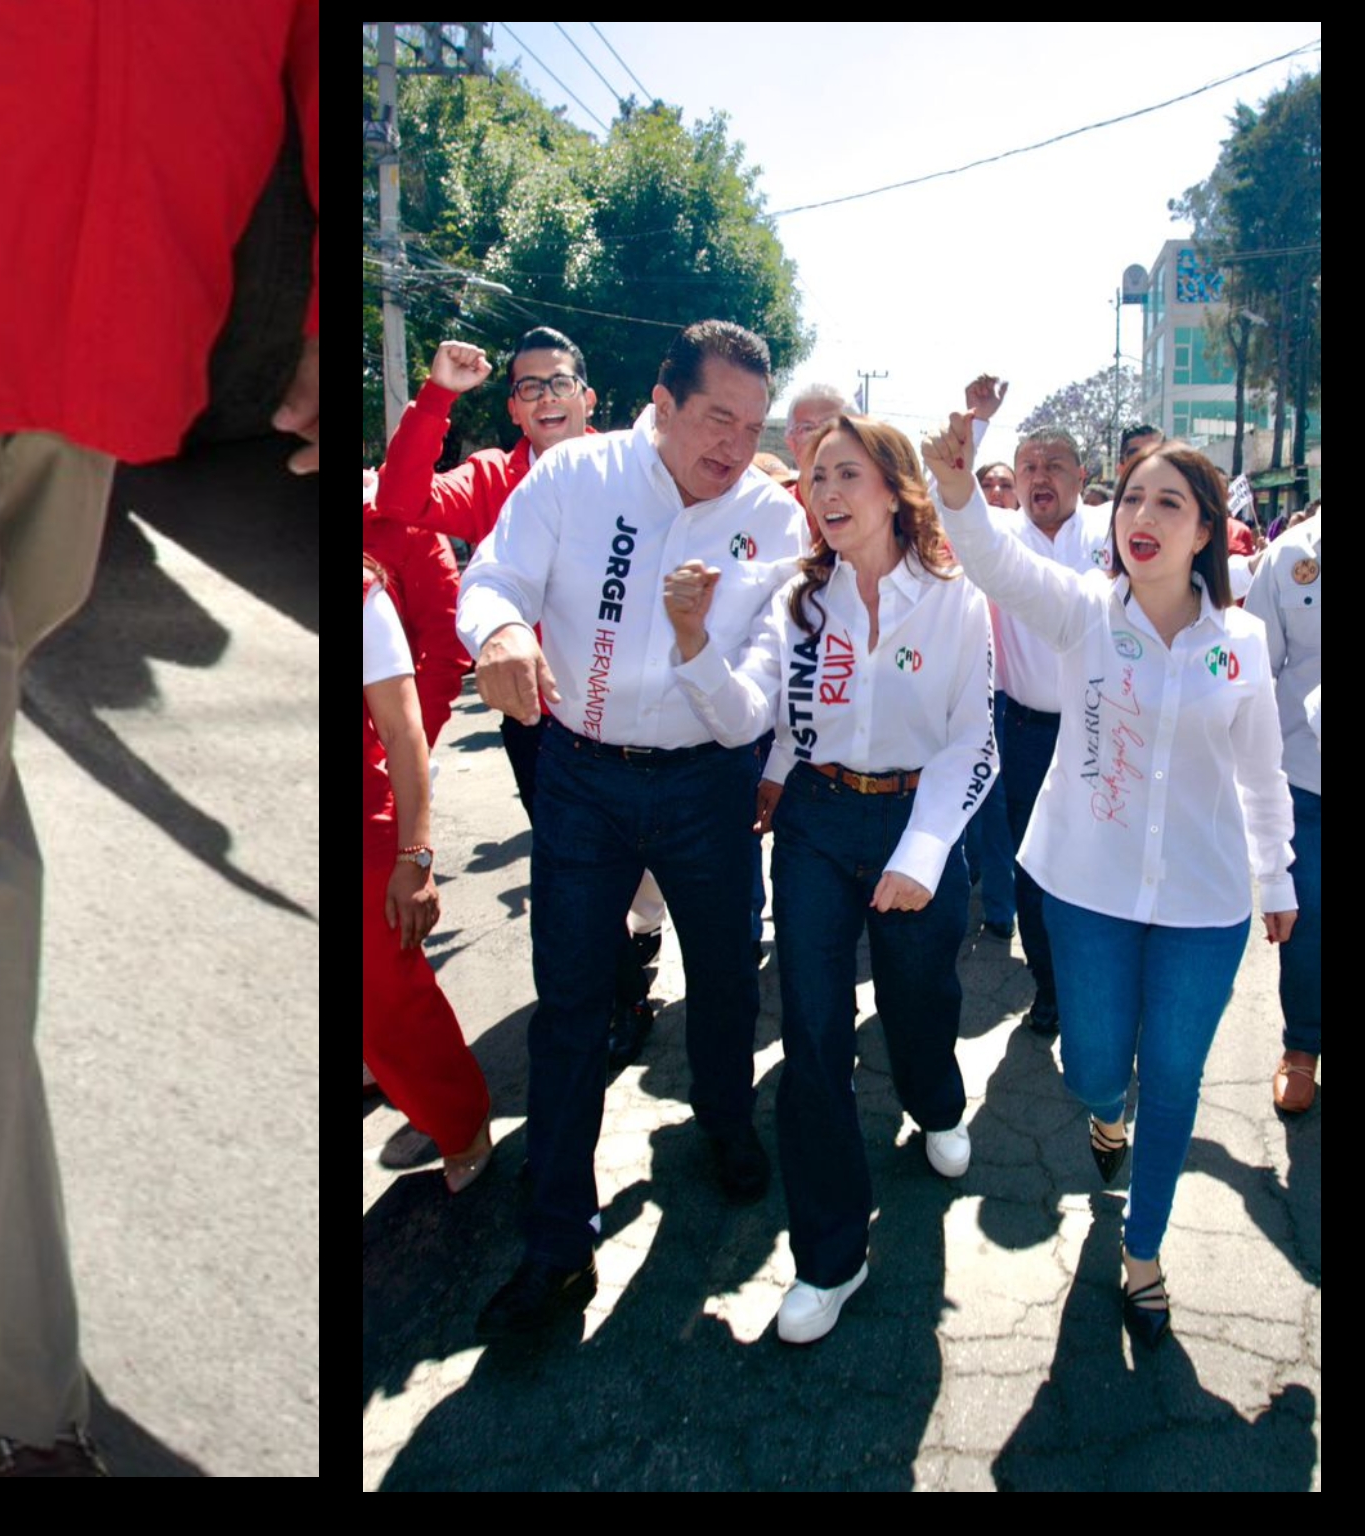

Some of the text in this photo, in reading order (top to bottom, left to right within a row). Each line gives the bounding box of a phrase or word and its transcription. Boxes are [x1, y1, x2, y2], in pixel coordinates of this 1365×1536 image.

[731, 534, 757, 558] PRI
[598, 515, 639, 623] JORGE
[819, 629, 856, 705] RUIZ
[896, 648, 921, 671] PRI
[1206, 648, 1239, 679] PRI
